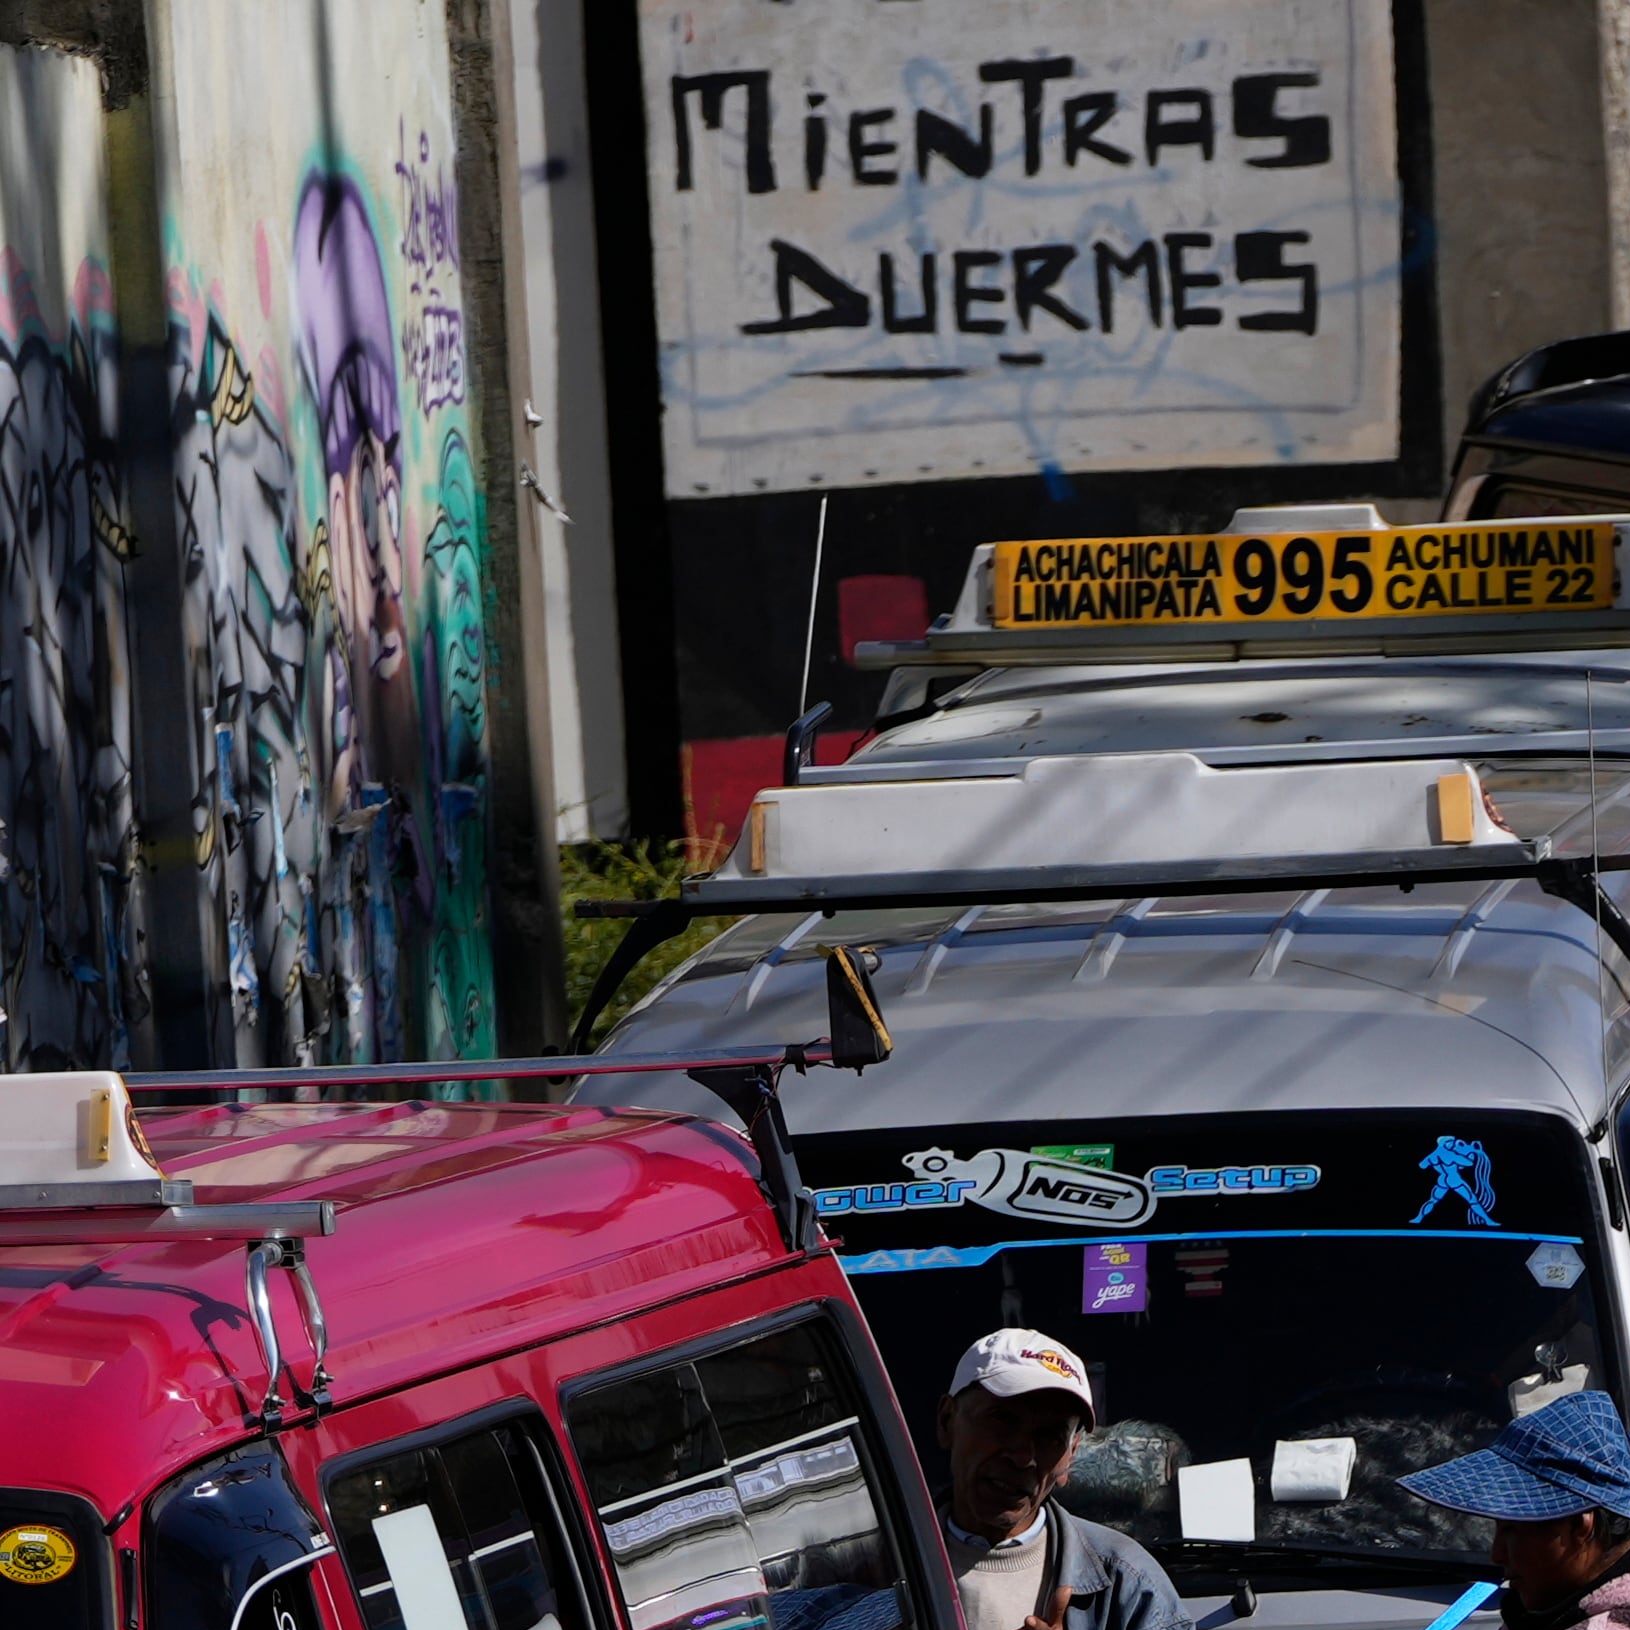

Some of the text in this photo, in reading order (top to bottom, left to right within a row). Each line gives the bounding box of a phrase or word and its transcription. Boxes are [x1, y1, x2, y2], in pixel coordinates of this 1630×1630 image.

[741, 231, 1317, 335] DUERMES
[1014, 540, 1223, 583] ACHACHICALA
[1385, 528, 1595, 573] ACHUMANI
[1233, 536, 1374, 616] 995
[1385, 567, 1595, 611] CALLE 22
[1013, 579, 1223, 622] LIMANIPATA
[804, 1180, 976, 1214] ower
[1026, 1177, 1116, 1210] NOS
[1091, 1282, 1136, 1309] yape
[1020, 1349, 1055, 1363] Hard
